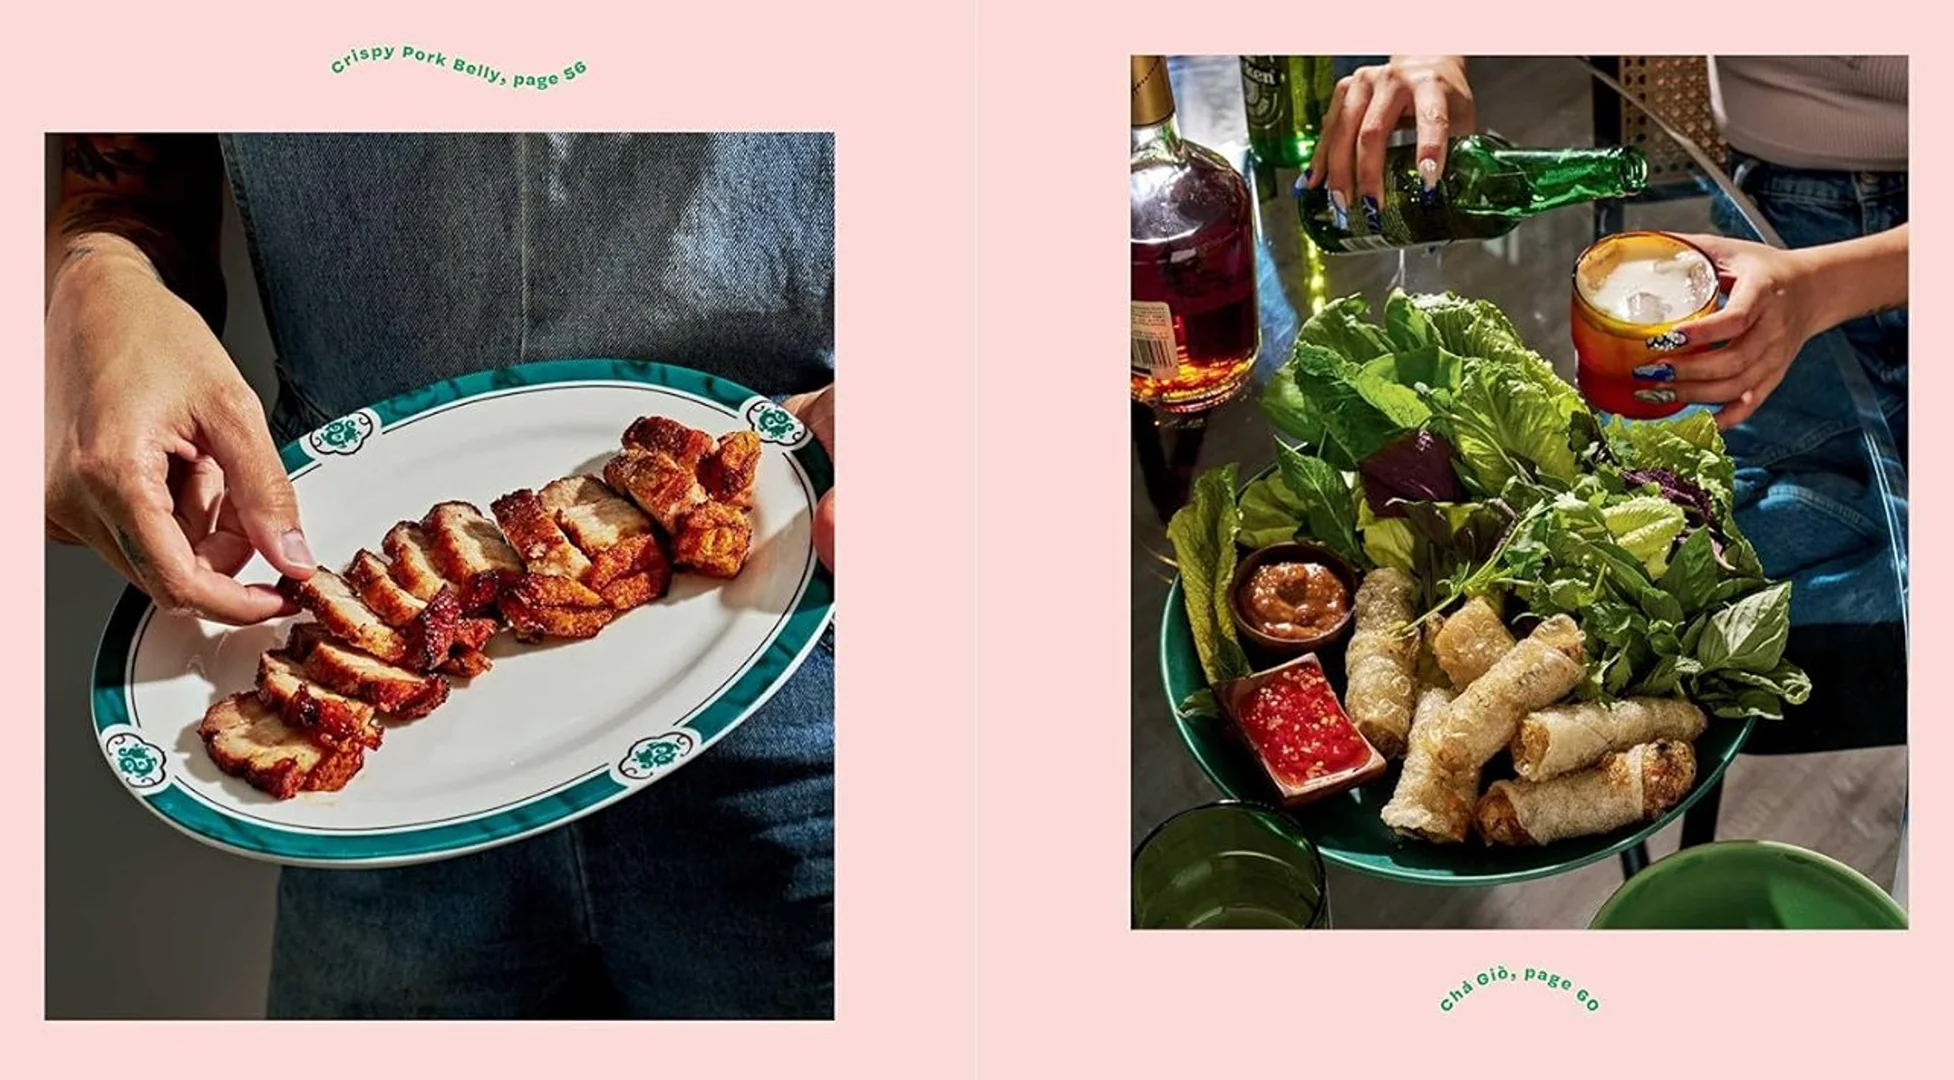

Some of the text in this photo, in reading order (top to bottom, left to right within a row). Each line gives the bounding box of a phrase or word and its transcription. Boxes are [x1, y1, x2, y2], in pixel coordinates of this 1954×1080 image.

[331, 45, 587, 91] Crispy Pork Belly, page 56
[1476, 965, 1517, 986] Giò,
[1524, 967, 1572, 991] page
[1576, 988, 1600, 1012] 60
